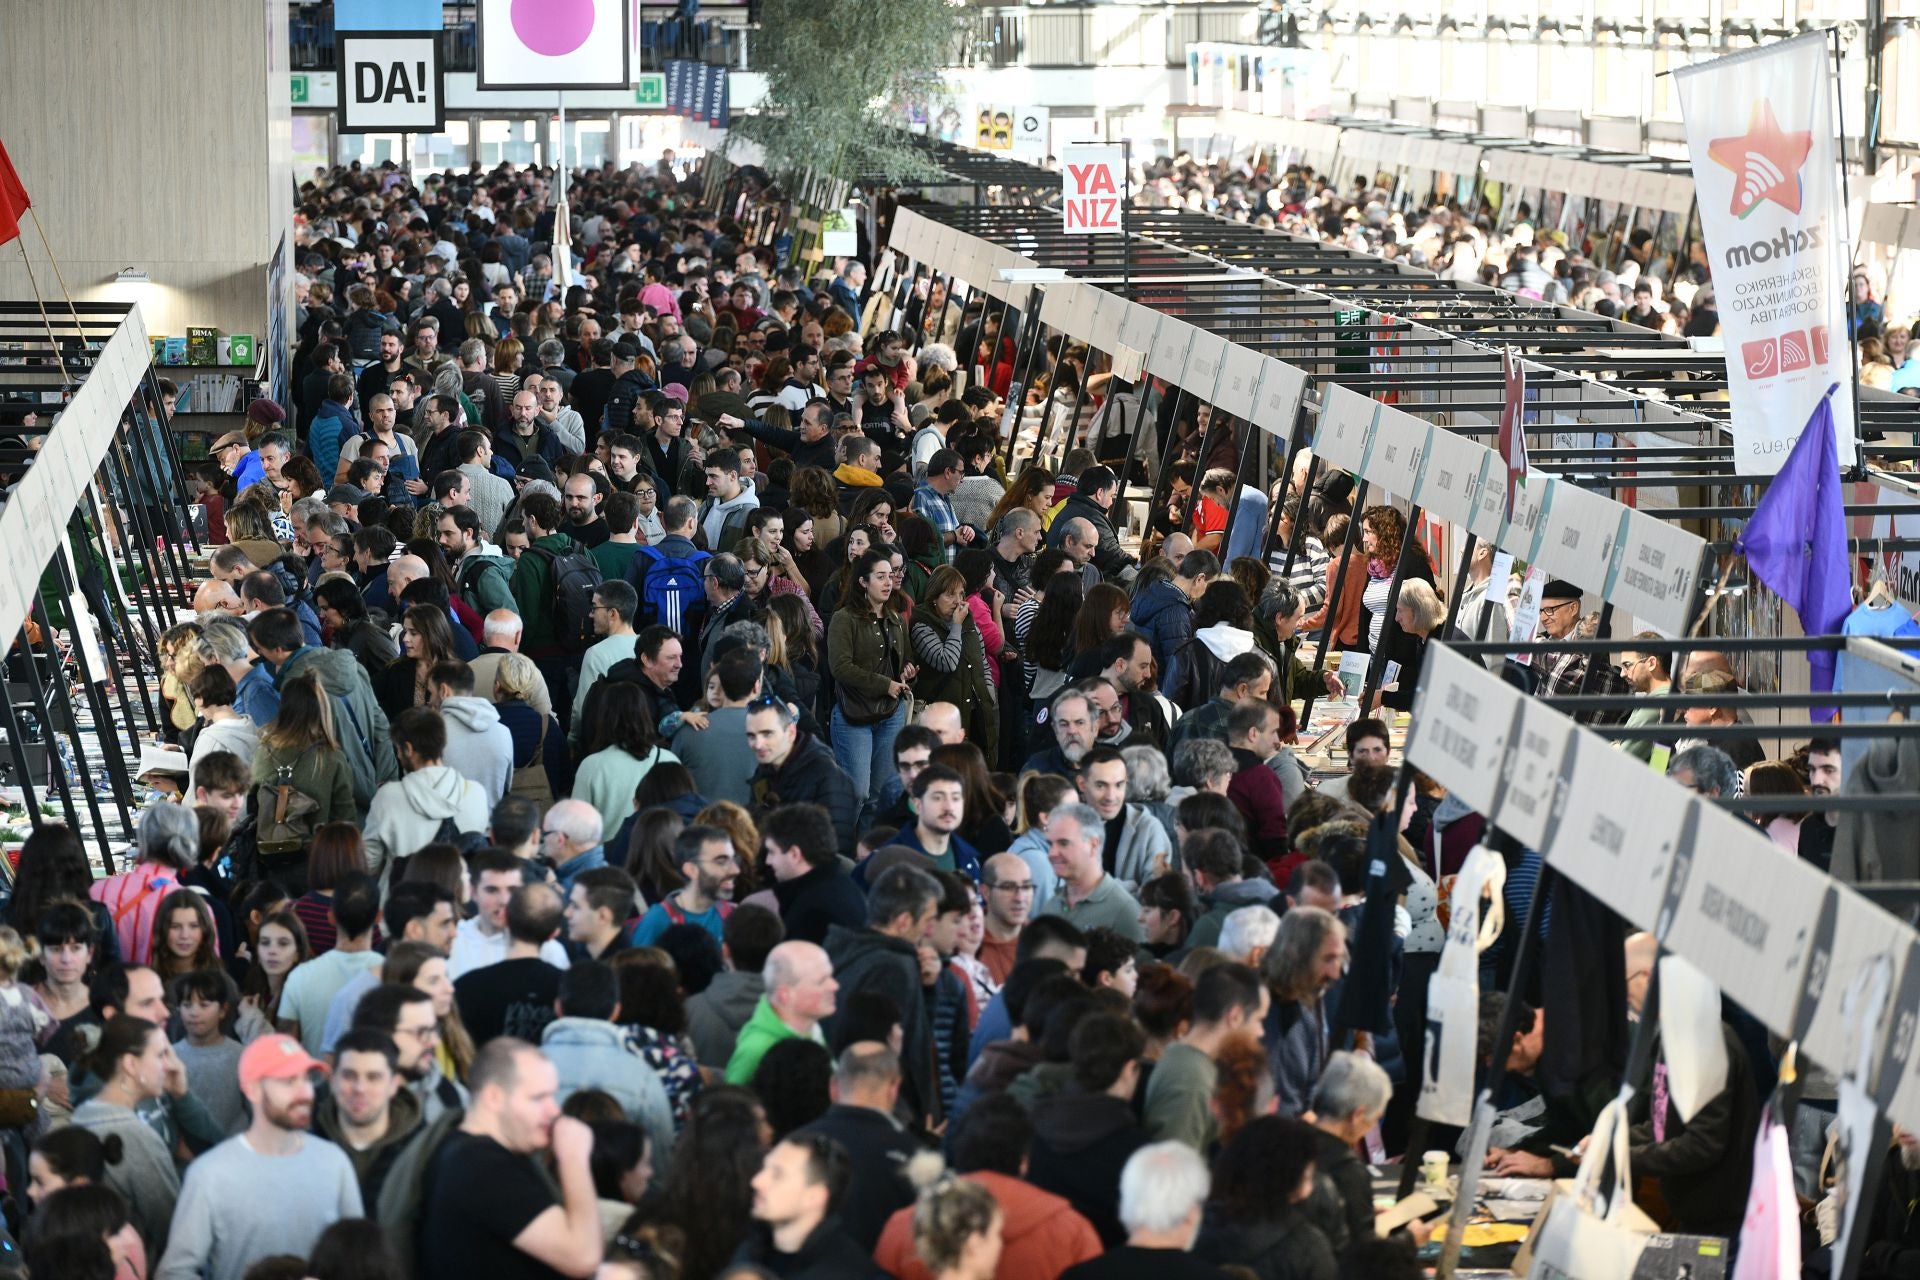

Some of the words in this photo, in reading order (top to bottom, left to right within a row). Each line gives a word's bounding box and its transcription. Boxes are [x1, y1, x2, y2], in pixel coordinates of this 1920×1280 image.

[354, 61, 427, 104] DA!
[1067, 164, 1117, 195] YA
[1067, 199, 1118, 228] NIZ
